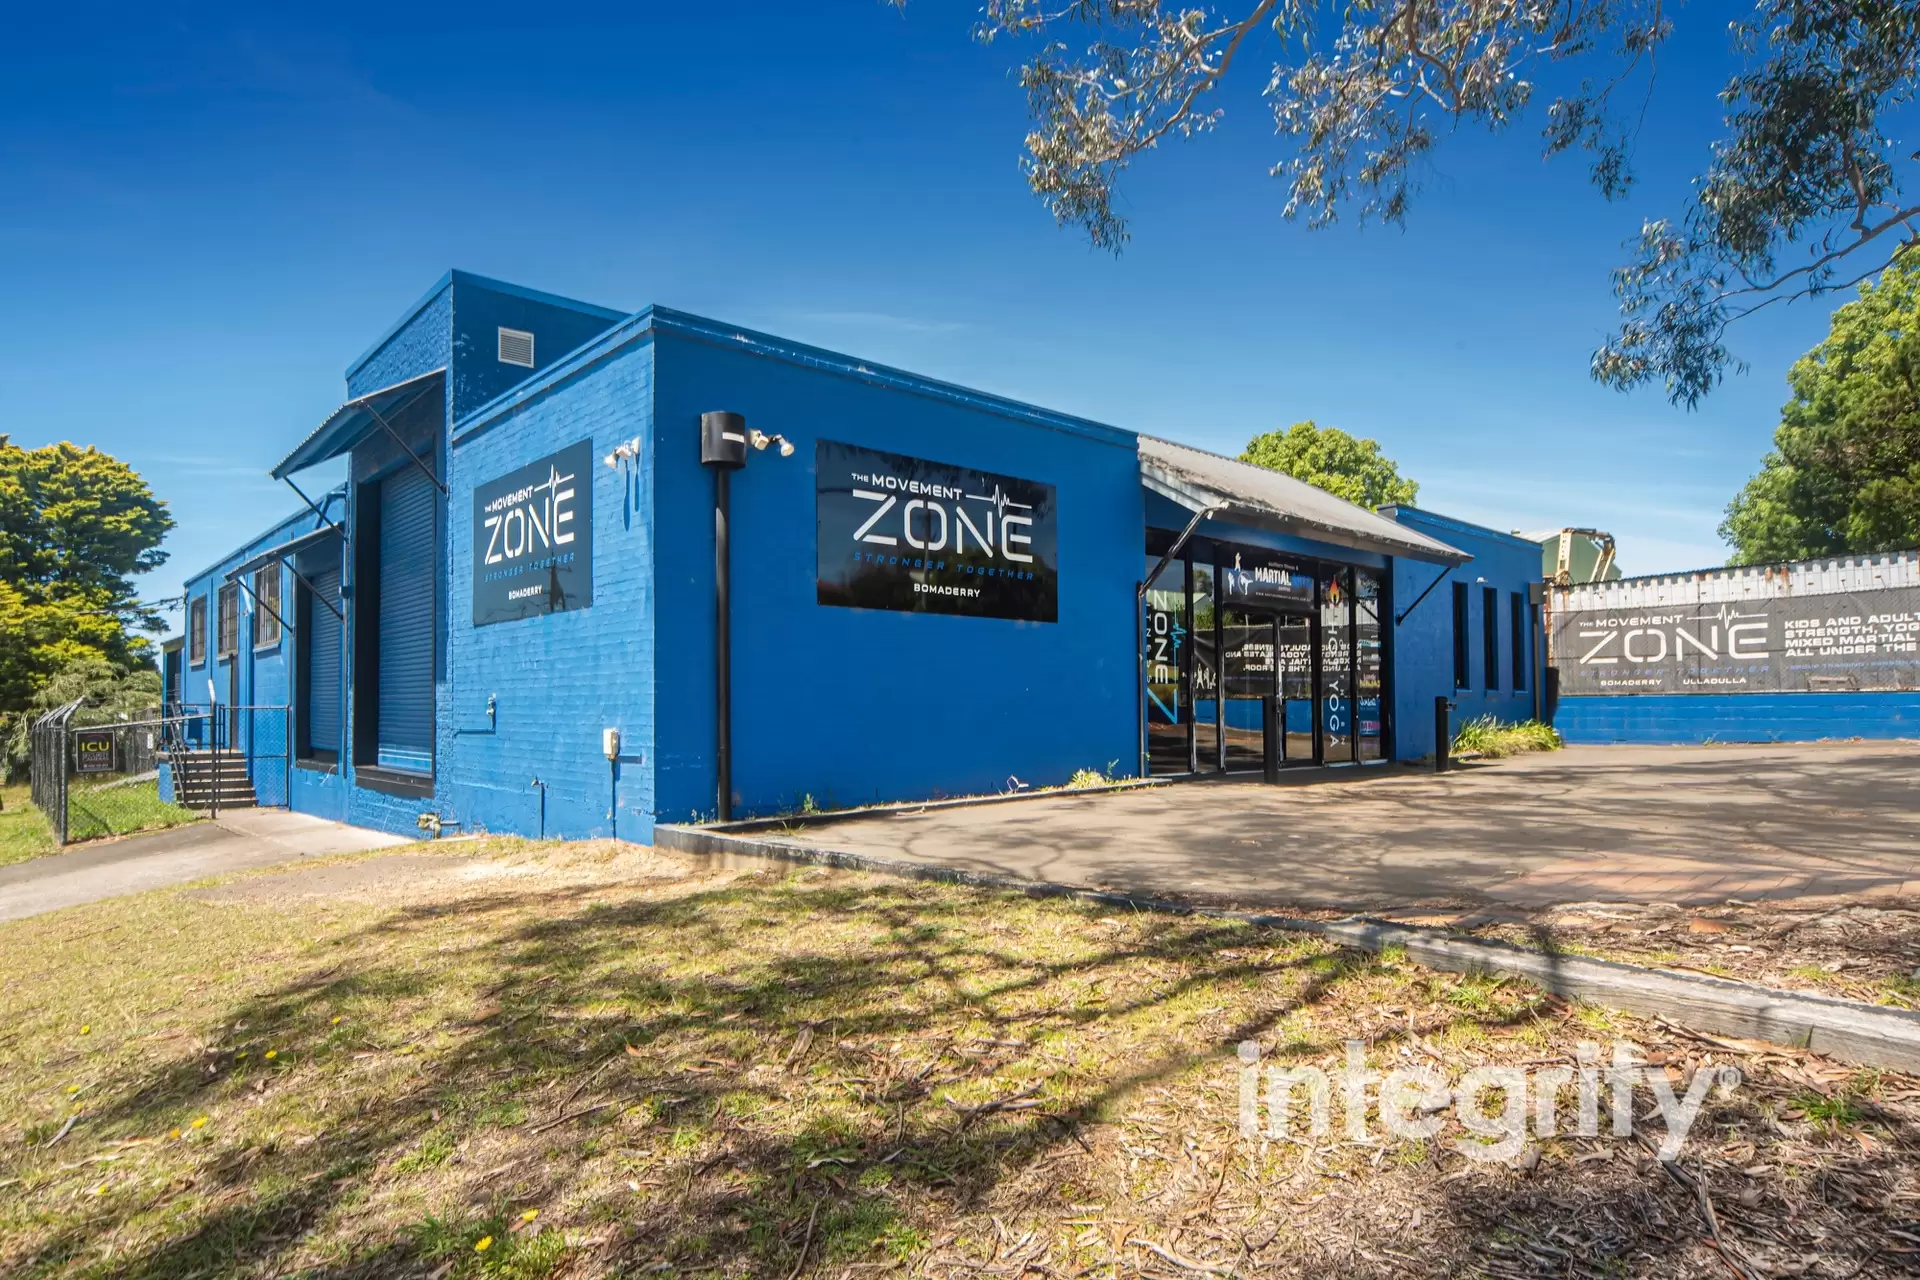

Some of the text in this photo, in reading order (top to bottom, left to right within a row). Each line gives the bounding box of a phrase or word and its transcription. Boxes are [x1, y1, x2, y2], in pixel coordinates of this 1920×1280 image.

[852, 473, 963, 500] THE MOVEMENT
[492, 485, 533, 512] MOVEMENT
[484, 488, 575, 565] ZONE
[853, 489, 1033, 563] ZONE
[484, 552, 575, 583] STRONGER TOGETHER
[854, 553, 1034, 580] STRONGER TOGETHER
[1255, 567, 1291, 586] MARTIAL
[508, 584, 543, 600] BOMADERRY
[914, 583, 981, 598] BOMADERRY
[1596, 614, 1684, 628] MOVEMENT
[1784, 619, 1820, 629] KIDS
[1826, 616, 1861, 626] AND
[1153, 589, 1168, 684] ZONE
[1785, 625, 1877, 638] STRENGTH,
[1785, 633, 1916, 648] MIXED MARTIAL
[1579, 622, 1770, 664] ZONE
[1785, 642, 1917, 657] ALL UNDER THE
[1600, 677, 1747, 687] BOMADERRY ULLADULLA
[1329, 680, 1339, 747] YOGA
[81, 741, 109, 751] ICU
